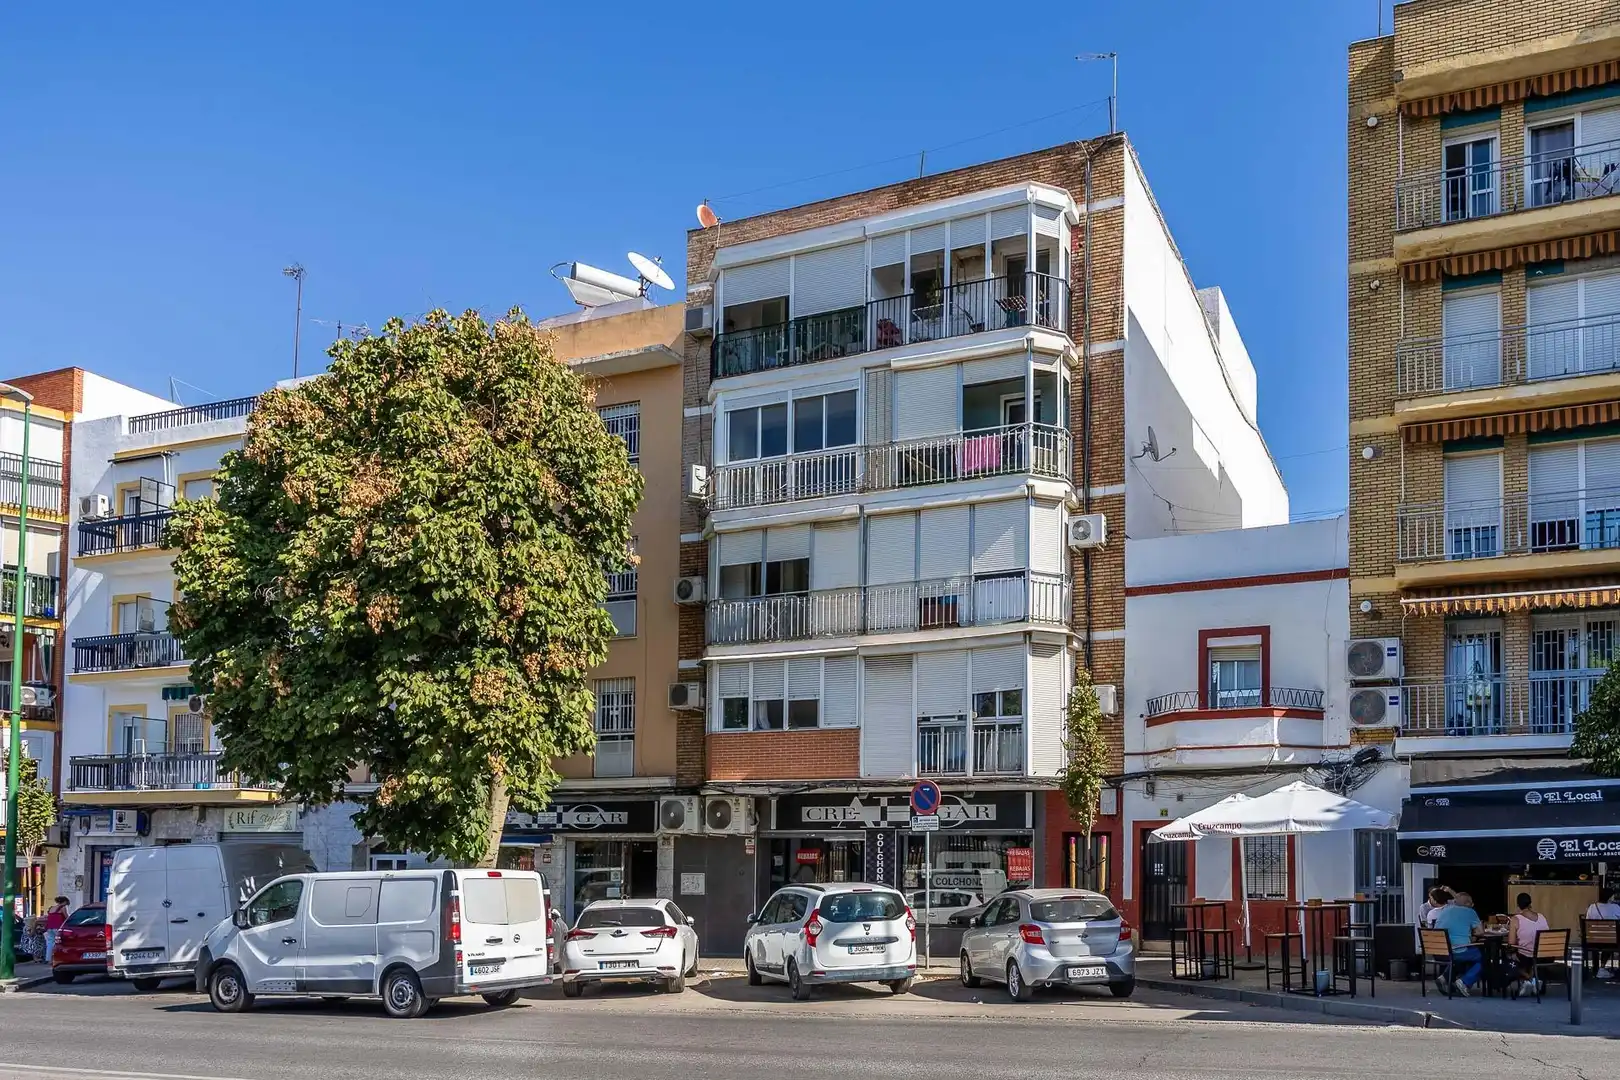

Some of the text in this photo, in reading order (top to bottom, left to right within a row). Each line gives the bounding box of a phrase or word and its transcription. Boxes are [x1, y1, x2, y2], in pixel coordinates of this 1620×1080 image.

[1543, 789, 1604, 802] El Local
[237, 809, 258, 825] Rif
[1197, 822, 1242, 831] Cruzcampo
[1559, 839, 1580, 852] El
[1072, 969, 1090, 977] 6973
